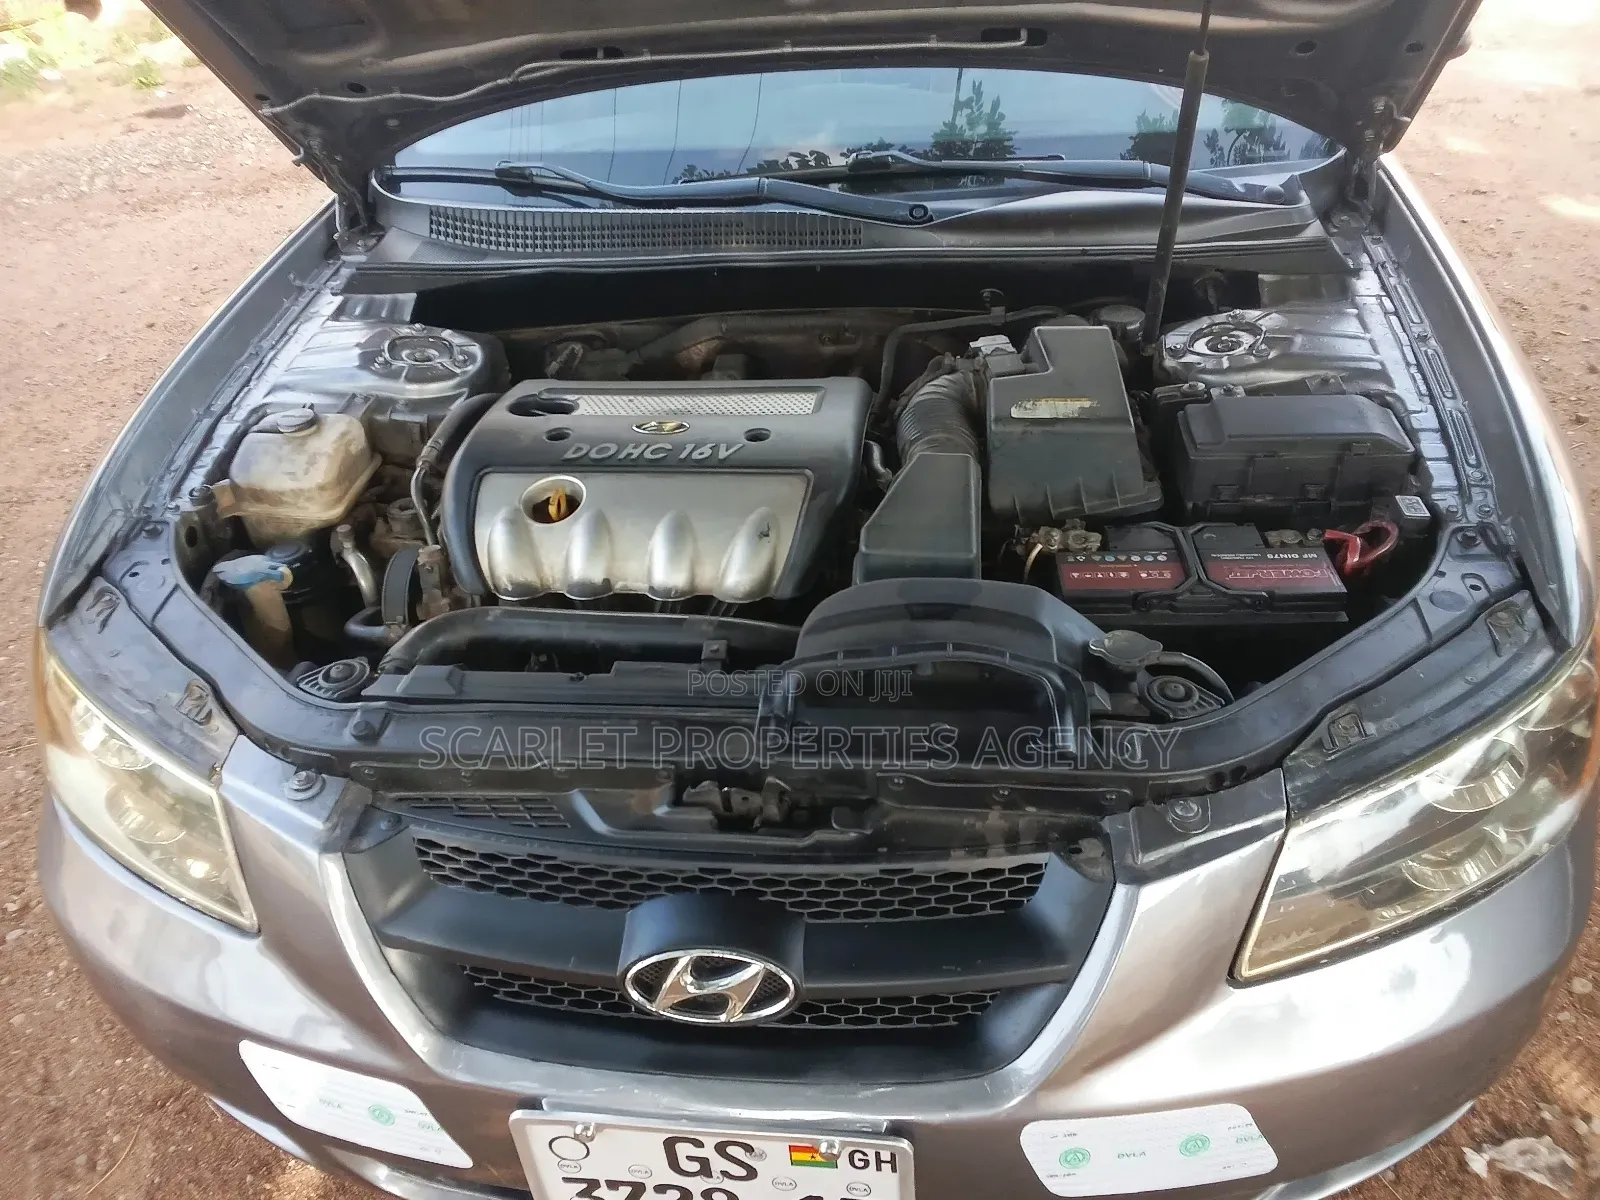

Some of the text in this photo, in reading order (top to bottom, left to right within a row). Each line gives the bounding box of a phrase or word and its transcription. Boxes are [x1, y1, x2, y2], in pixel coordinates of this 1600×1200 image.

[560, 443, 745, 461] DOHC 16V
[662, 1136, 759, 1181] GS
[847, 1149, 898, 1174] GH
[561, 1176, 741, 1200] 37
